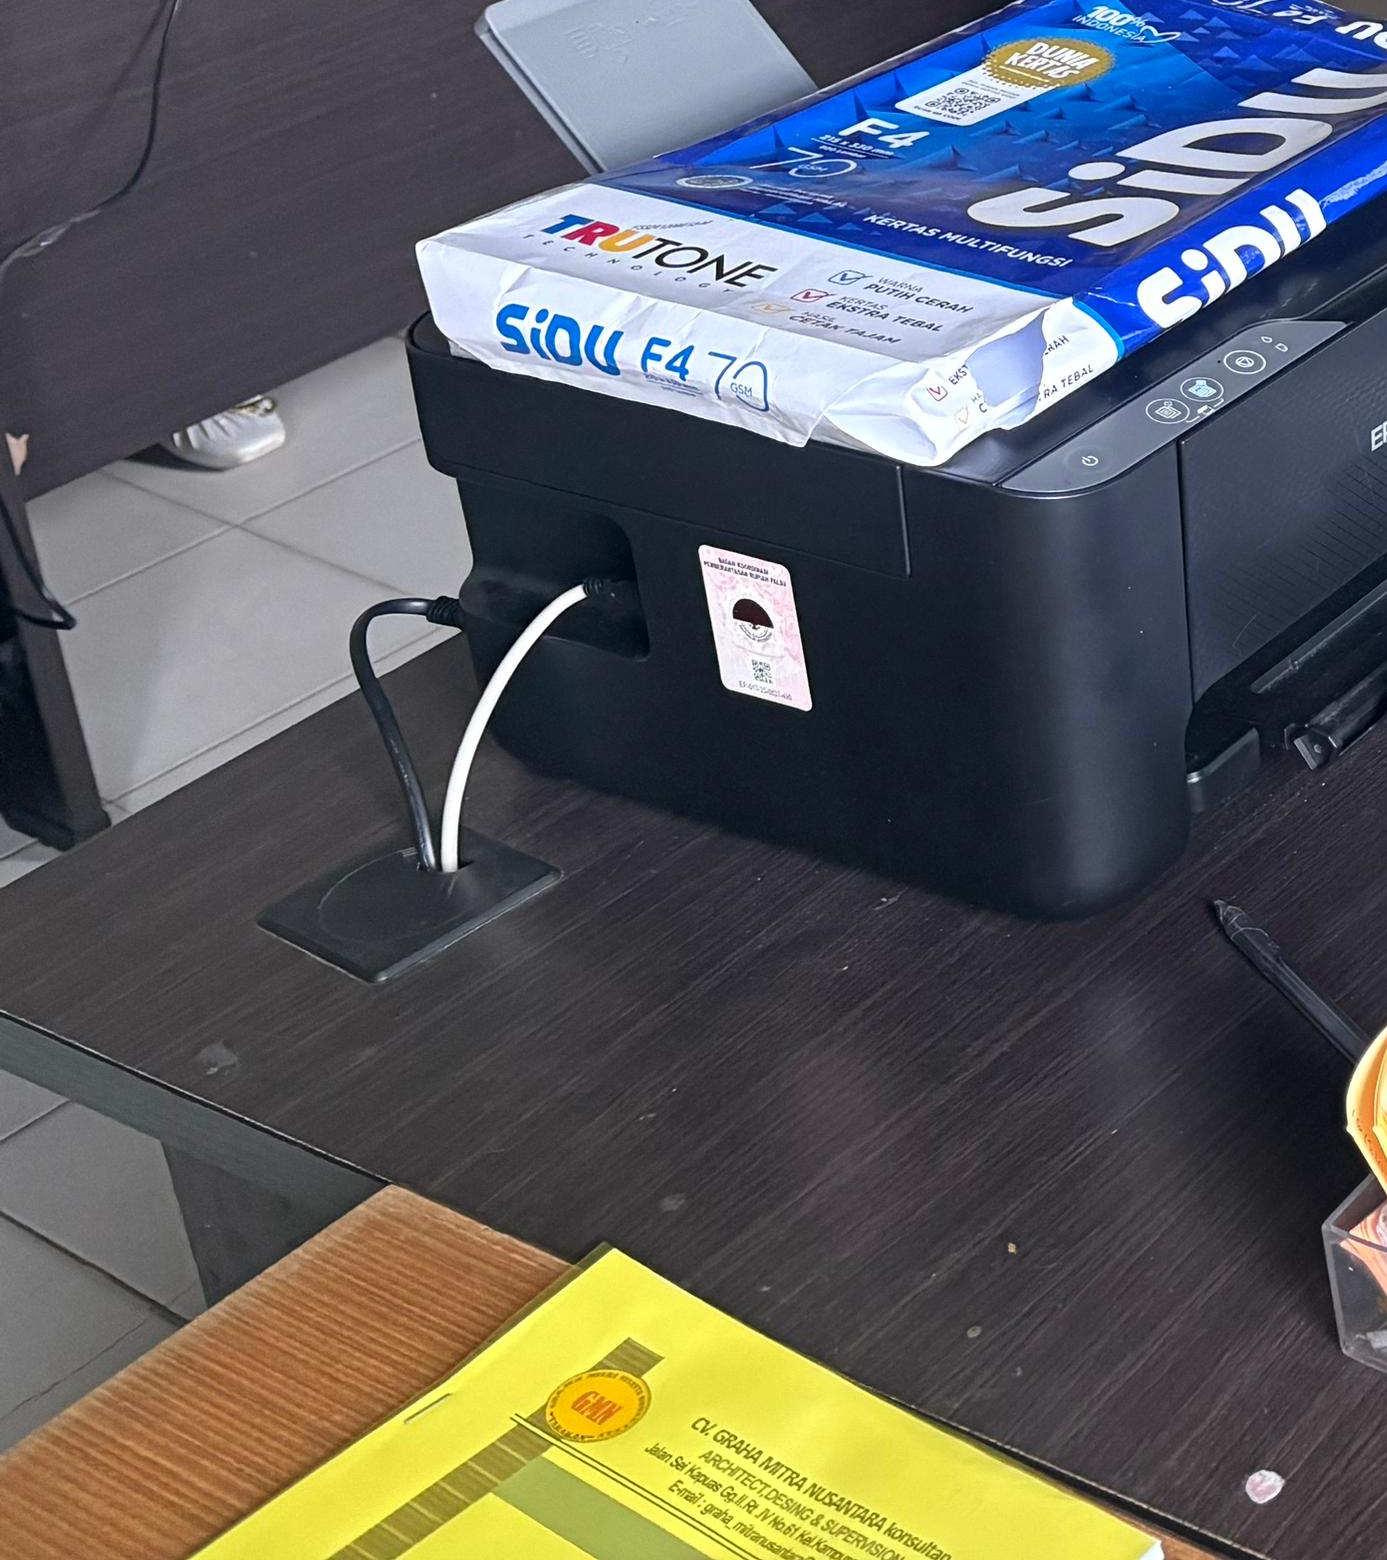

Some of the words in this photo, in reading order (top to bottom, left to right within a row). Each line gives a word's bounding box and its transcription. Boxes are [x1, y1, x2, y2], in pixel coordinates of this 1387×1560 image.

[1072, 15, 1146, 42] INDONESIA
[1087, 6, 1147, 28] 100%
[1025, 41, 1100, 69] DUNIA
[838, 118, 930, 149] F4
[750, 147, 857, 177] 70
[541, 213, 779, 288] TRUTONE
[863, 214, 942, 237] KERTAS
[938, 232, 1073, 268] MULTIFUNGSI
[523, 234, 735, 293] TECHNOLOGY
[864, 283, 916, 300] PUTIH
[915, 296, 974, 314] CERAH
[877, 277, 924, 293] WARNA
[826, 301, 890, 320] EKSTRA
[892, 315, 944, 332] TEBAL
[839, 296, 888, 310] KERTAS
[789, 315, 843, 331] CETAK
[844, 328, 901, 344] TAJAM
[495, 303, 625, 377] SiDU
[640, 336, 695, 382] F4
[708, 350, 770, 413] 70
[1044, 335, 1070, 355] RAH
[730, 382, 753, 397] GSM
[1061, 364, 1094, 389] TEBAL
[644, 1443, 673, 1464] Jalan
[669, 1456, 691, 1472] Sei
[684, 1465, 723, 1493] Kapuas
[691, 1417, 717, 1436] CV.
[712, 1429, 763, 1464] GRAHA
[759, 1456, 808, 1491] MITRA
[803, 1483, 888, 1532] NUSANTARA
[668, 1479, 704, 1505] E-mail
[809, 1513, 825, 1528] &
